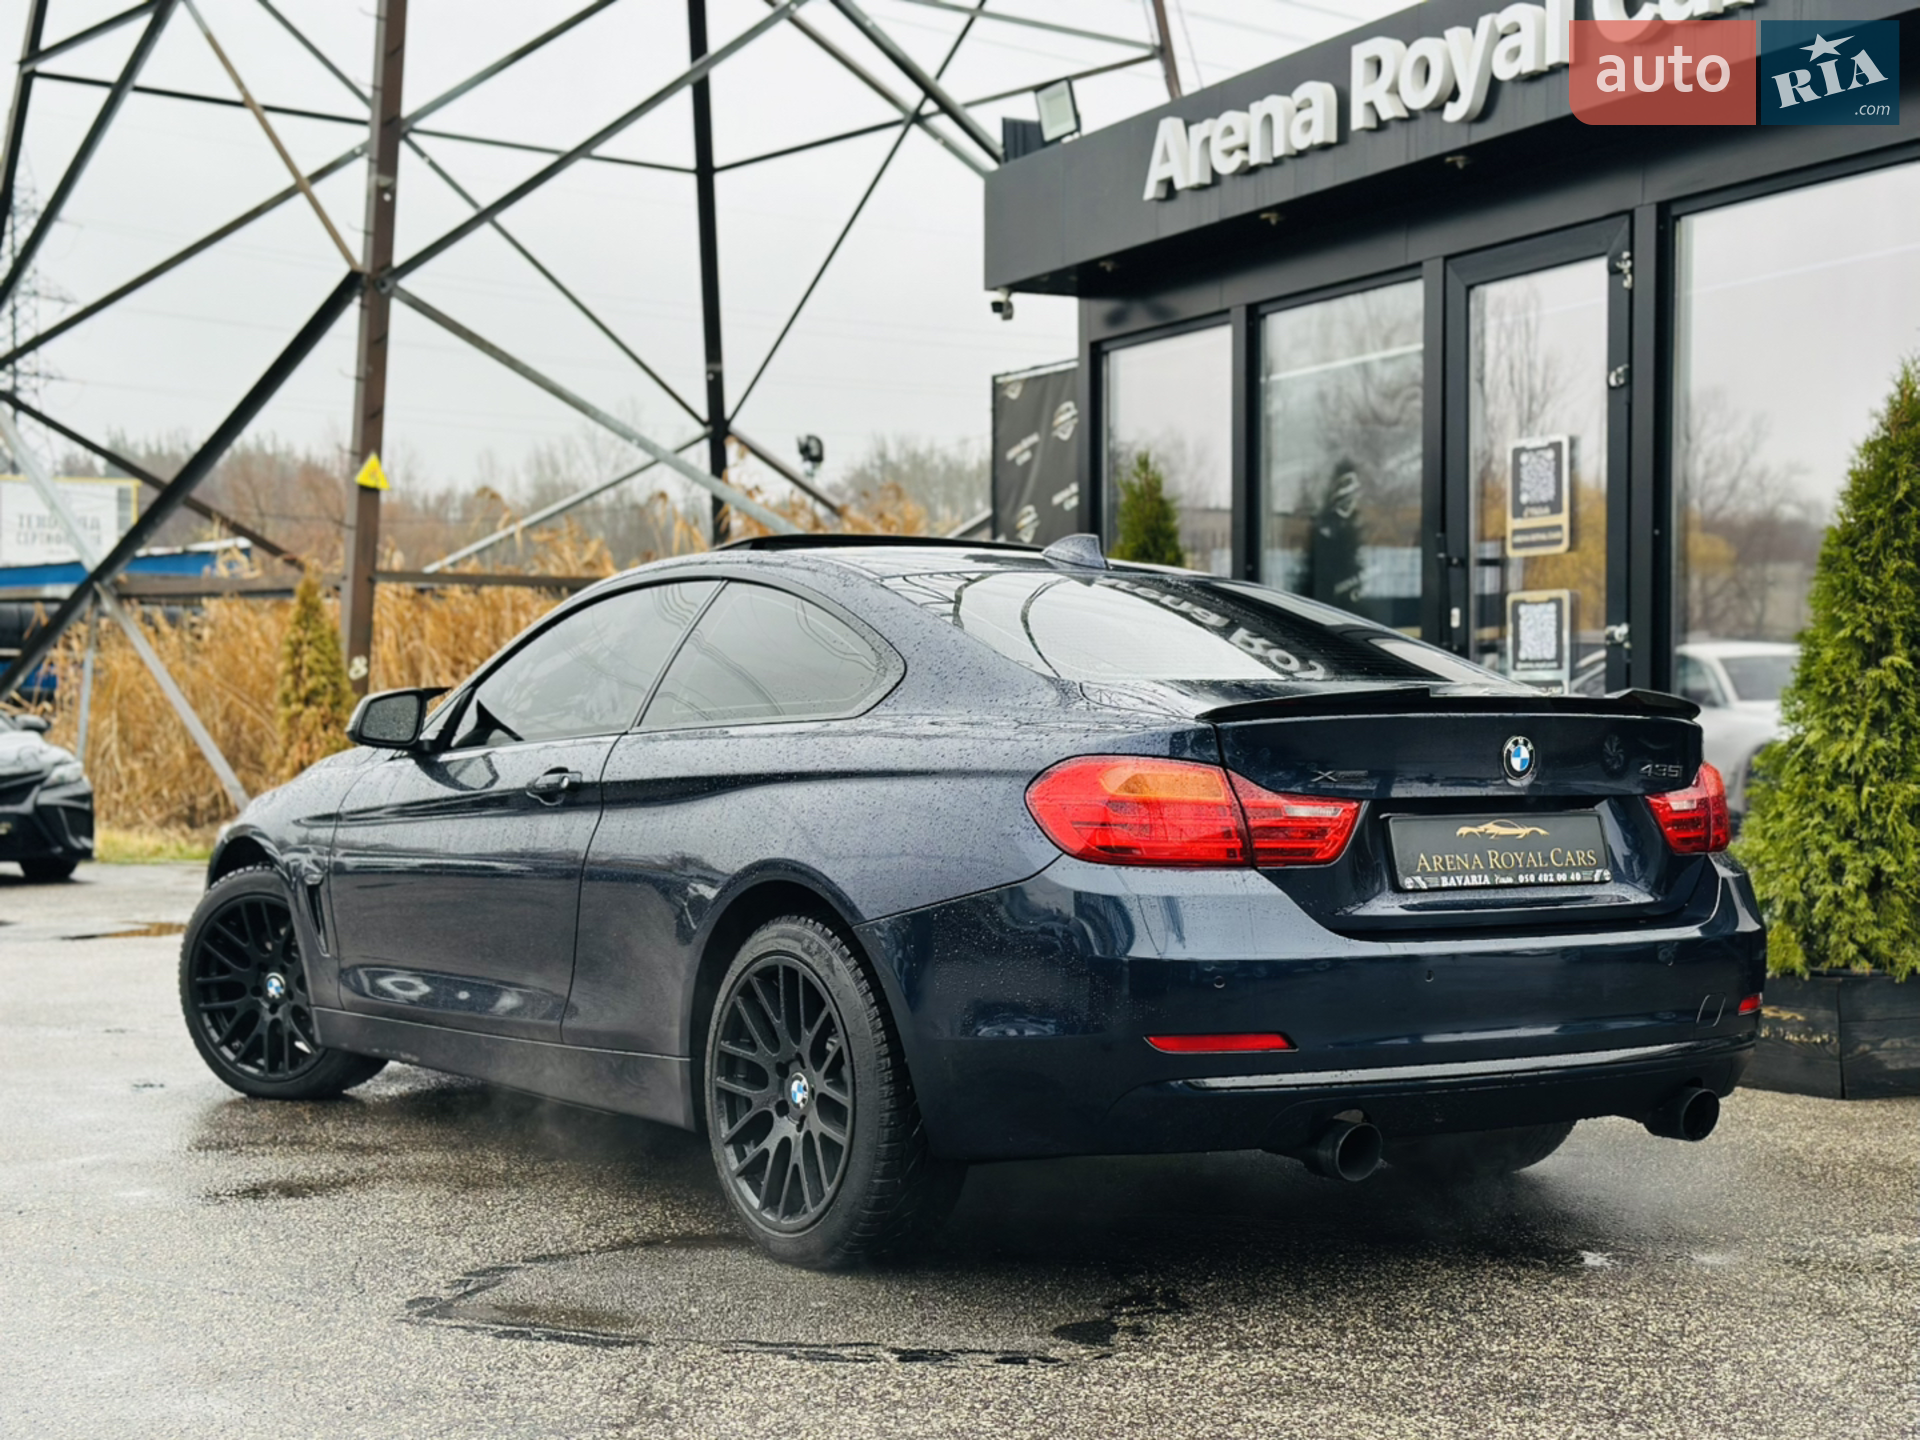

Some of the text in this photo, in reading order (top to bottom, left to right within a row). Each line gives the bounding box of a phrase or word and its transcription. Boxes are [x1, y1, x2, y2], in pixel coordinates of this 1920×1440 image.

[1144, 0, 1575, 200] Arena Royal
[1416, 847, 1597, 872] ARENA ROYAL CARS
[1441, 874, 1491, 887] BAVARIA
